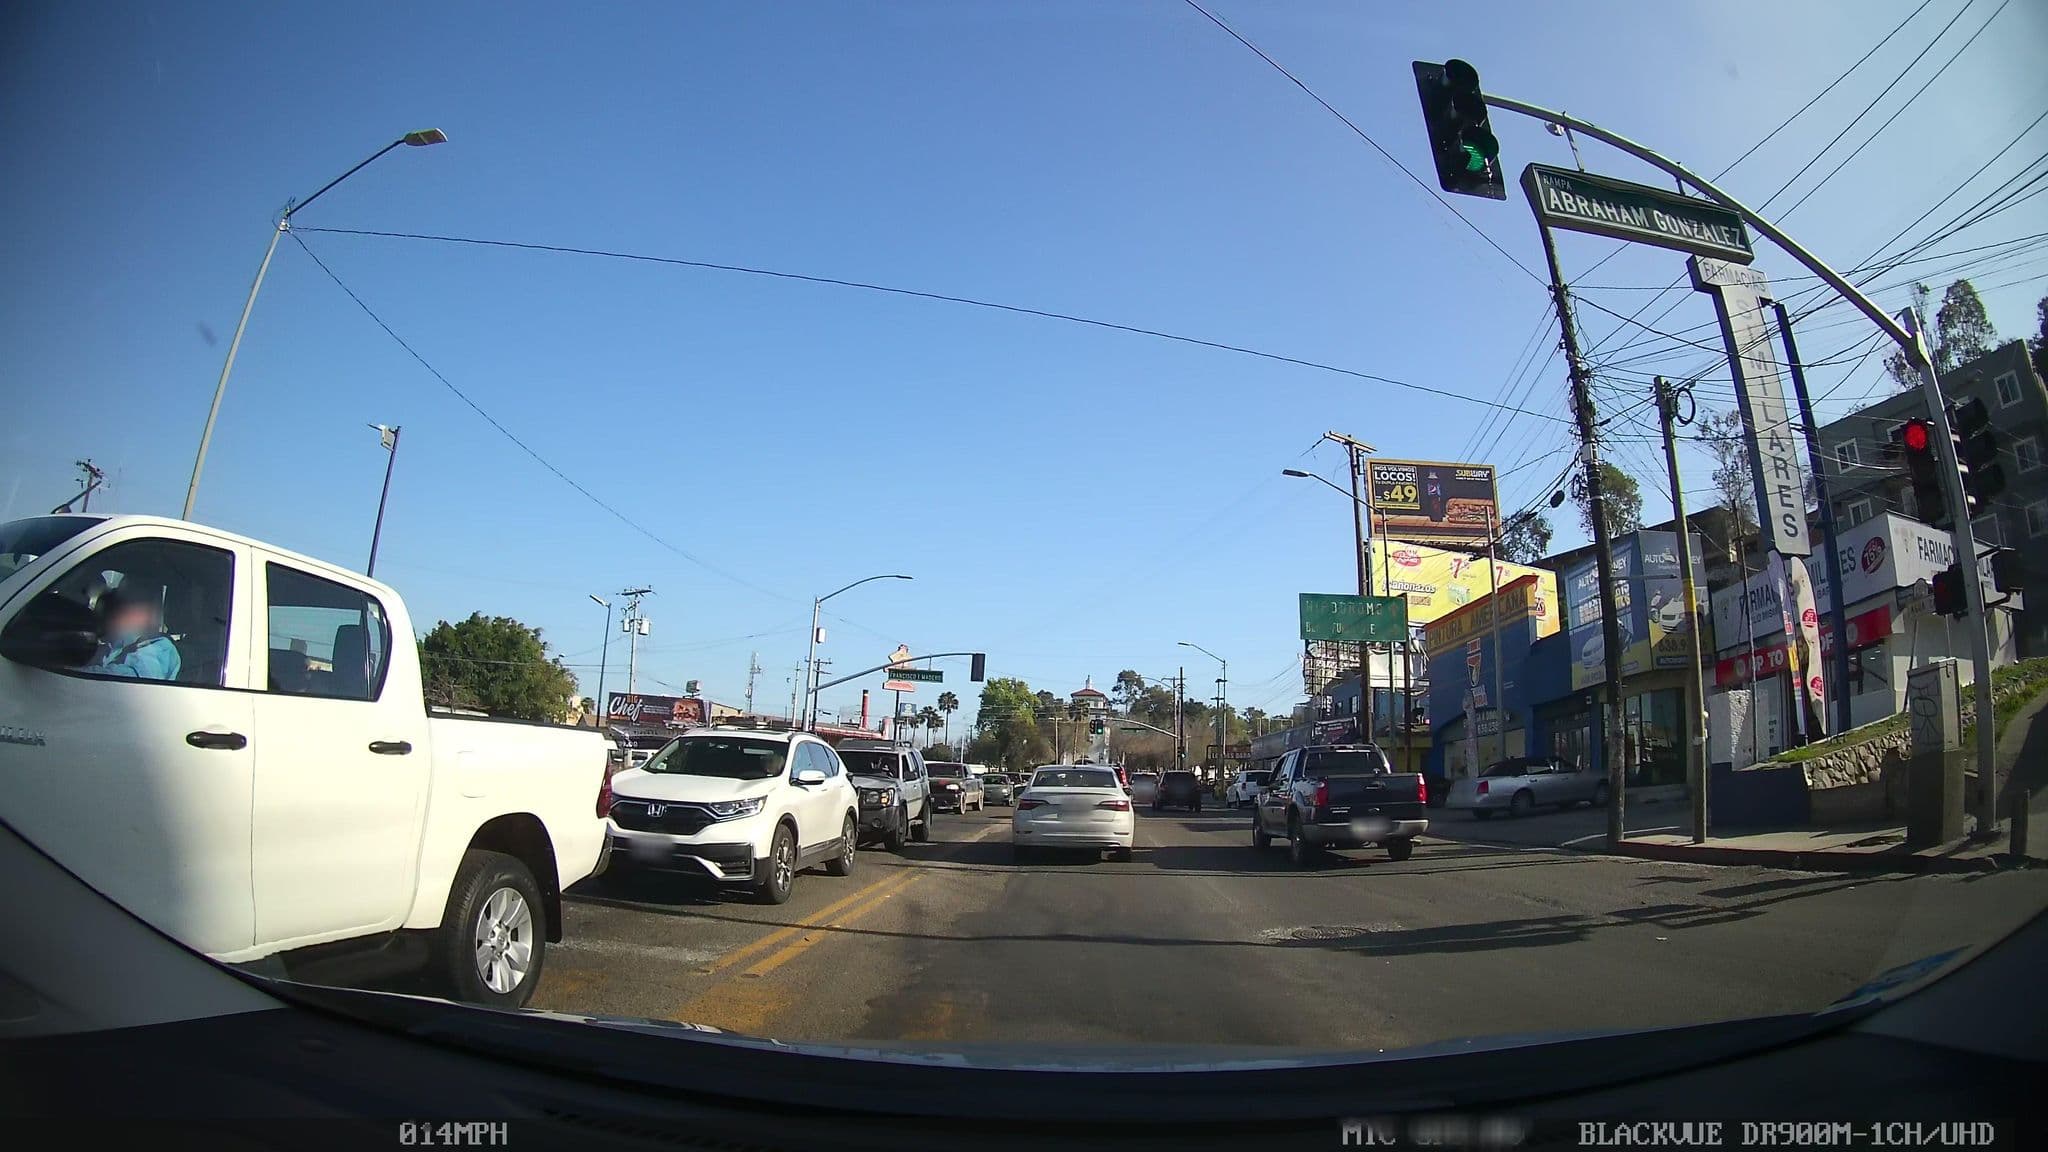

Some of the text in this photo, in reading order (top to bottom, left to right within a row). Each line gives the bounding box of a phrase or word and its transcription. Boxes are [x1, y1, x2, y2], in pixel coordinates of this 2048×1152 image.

[1543, 175, 1572, 191] RAMPA
[1549, 187, 1746, 249] ABRAHAM GONZALEZ
[1703, 261, 1766, 293] FARMACIAS
[1374, 471, 1416, 482] LOCOS!
[1455, 469, 1490, 478] SUBWAY
[1383, 484, 1417, 503] $49
[1917, 536, 1954, 566] FARMAC
[1471, 587, 1527, 632] AMERCANA
[889, 671, 917, 681] FRANCISCO
[609, 696, 643, 722] Chef
